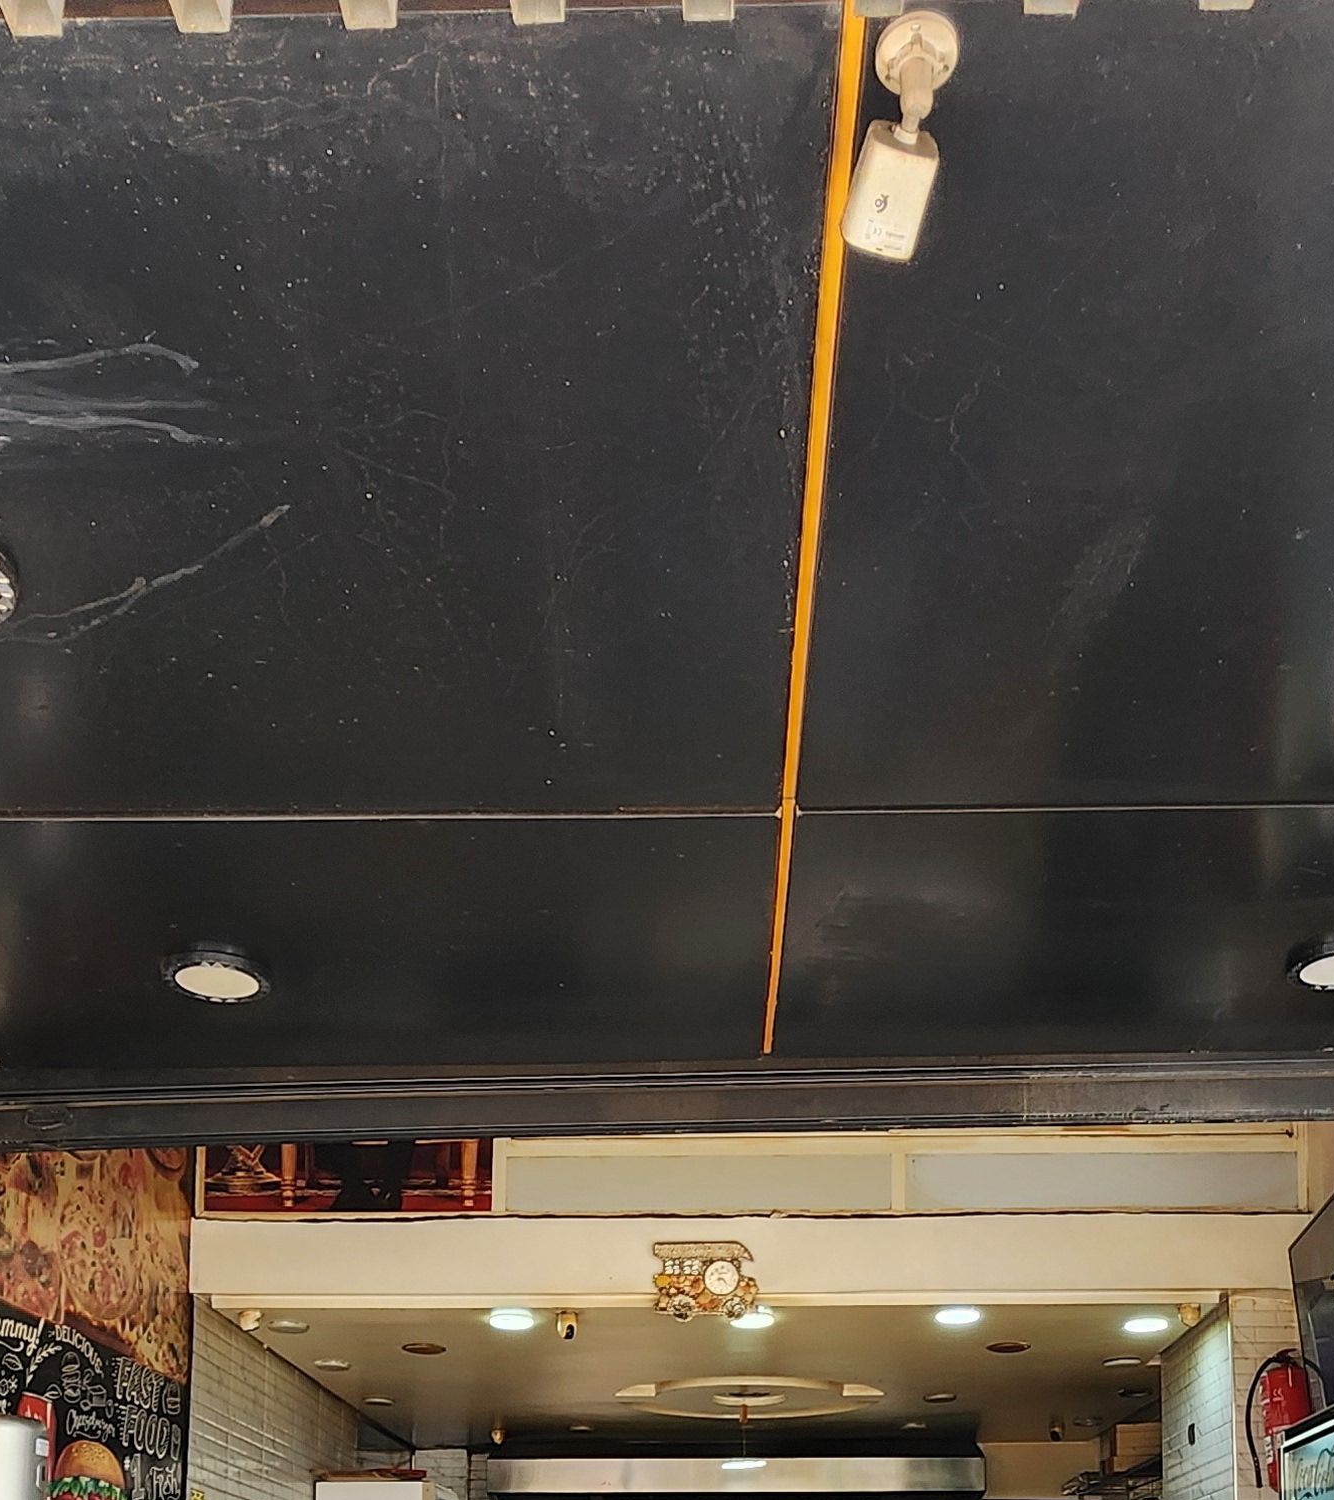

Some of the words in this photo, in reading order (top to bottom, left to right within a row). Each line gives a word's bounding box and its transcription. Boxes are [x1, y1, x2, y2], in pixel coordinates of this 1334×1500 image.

[55, 1325, 105, 1379] DELICIOUS
[117, 1356, 164, 1412] FAST
[122, 1405, 170, 1460] FOOD
